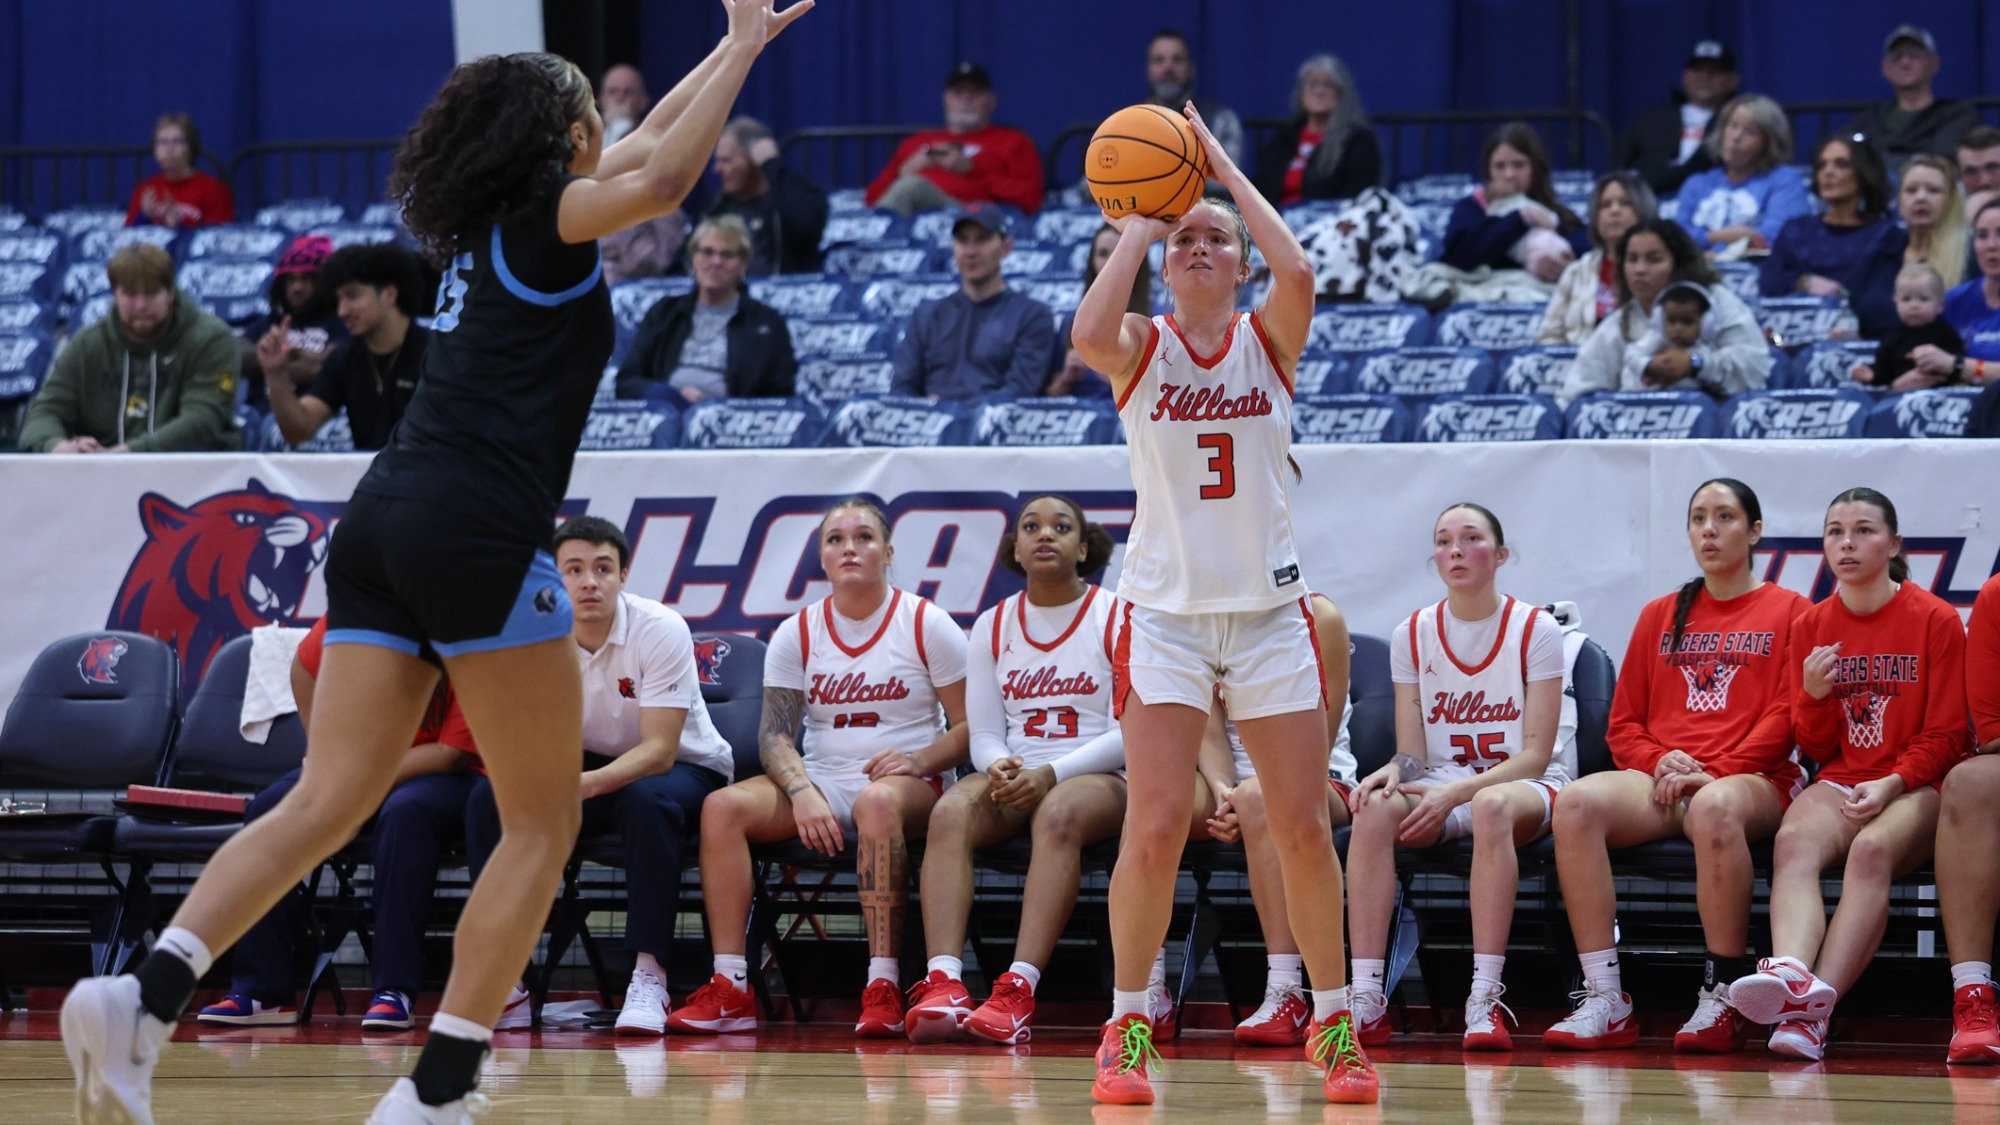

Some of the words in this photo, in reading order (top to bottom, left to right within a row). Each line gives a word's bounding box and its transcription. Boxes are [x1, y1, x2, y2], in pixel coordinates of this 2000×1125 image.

[1400, 357, 1479, 385] RSU
[1150, 383, 1273, 422] Hillcats
[1774, 401, 1861, 429] RSU
[725, 410, 806, 437] RSU
[873, 407, 954, 437] RSU
[1015, 408, 1098, 435] RSU
[1308, 407, 1395, 434] RSU
[1461, 404, 1548, 431] RSU
[1618, 405, 1703, 432] RSU
[1197, 432, 1236, 500] 3
[1659, 631, 1721, 656] RGERS
[1723, 631, 1775, 658] STATE
[1002, 665, 1099, 700] Hillcats
[1872, 654, 1919, 683] STATE
[808, 671, 910, 705] Hillcats
[1427, 690, 1521, 724] Hillcats
[1021, 705, 1079, 739] 23
